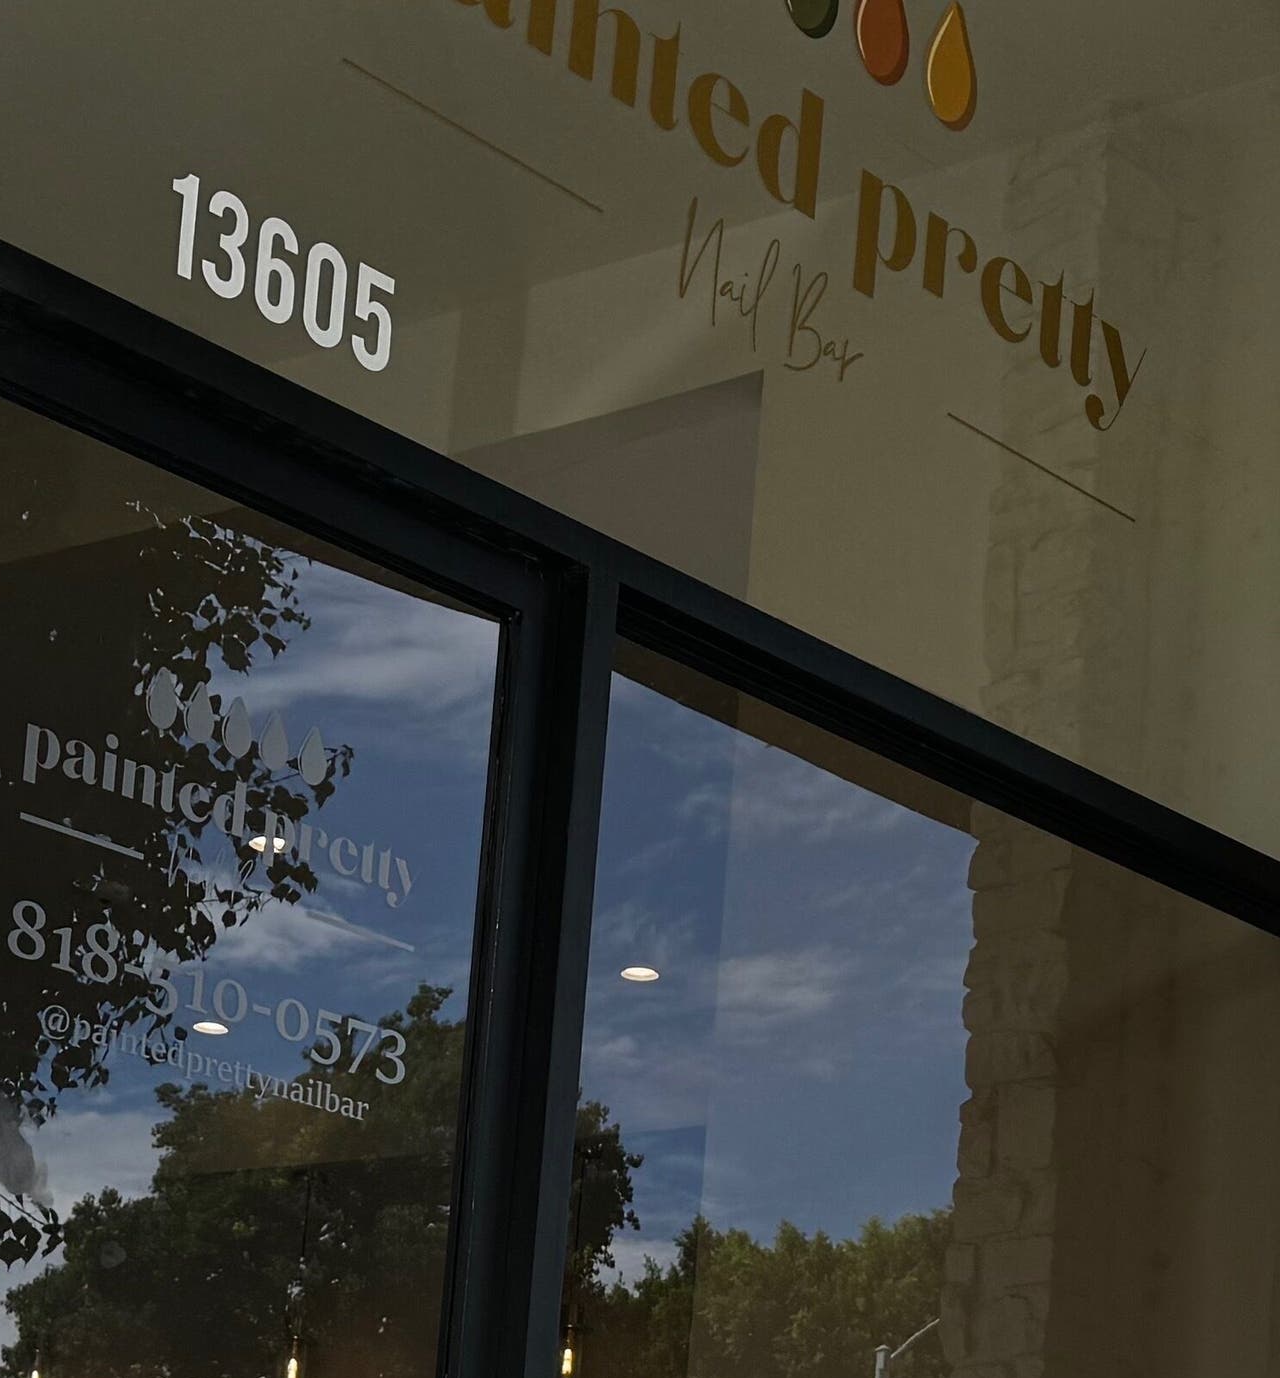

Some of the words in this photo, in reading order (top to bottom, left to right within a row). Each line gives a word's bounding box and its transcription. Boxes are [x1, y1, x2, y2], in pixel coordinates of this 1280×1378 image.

[173, 174, 396, 372] 13605
[454, 0, 824, 219] inted
[853, 170, 1147, 430] pretty
[679, 197, 780, 353] Nail
[783, 263, 864, 382] Bar
[22, 722, 246, 837] painted
[262, 812, 416, 908] pretty
[7, 900, 408, 1086] 818-510-0573
[39, 1004, 370, 1122] @paintedprettynailbar
